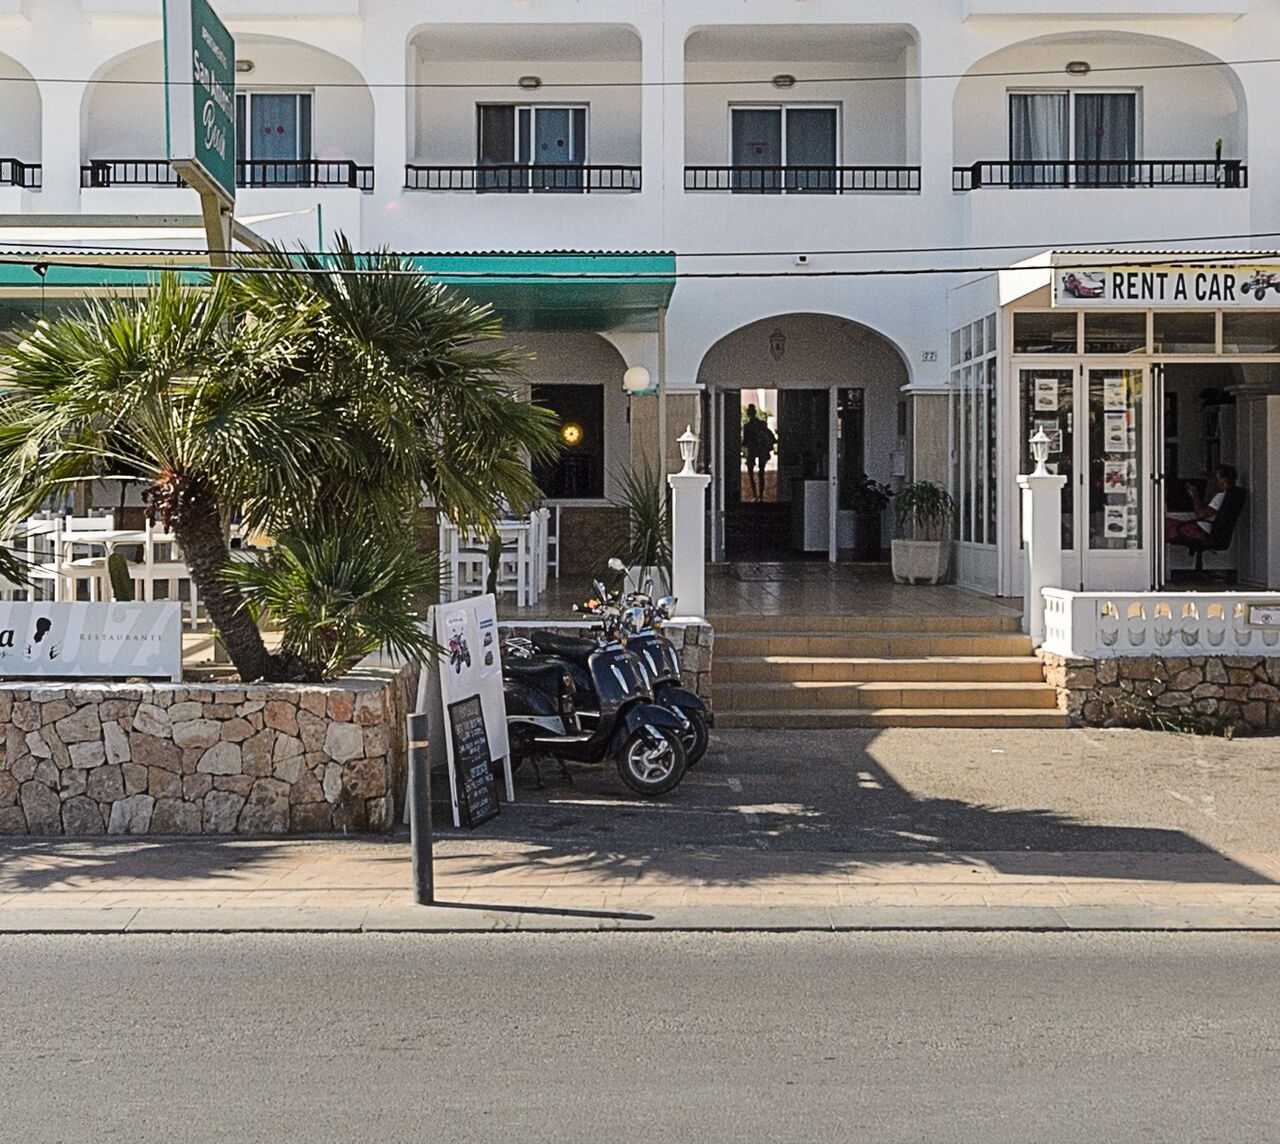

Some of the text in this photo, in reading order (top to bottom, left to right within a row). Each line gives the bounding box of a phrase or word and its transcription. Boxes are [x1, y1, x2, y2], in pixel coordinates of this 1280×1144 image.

[1111, 271, 1237, 302] RENT A CAR
[79, 632, 163, 642] RESTAURANTE
